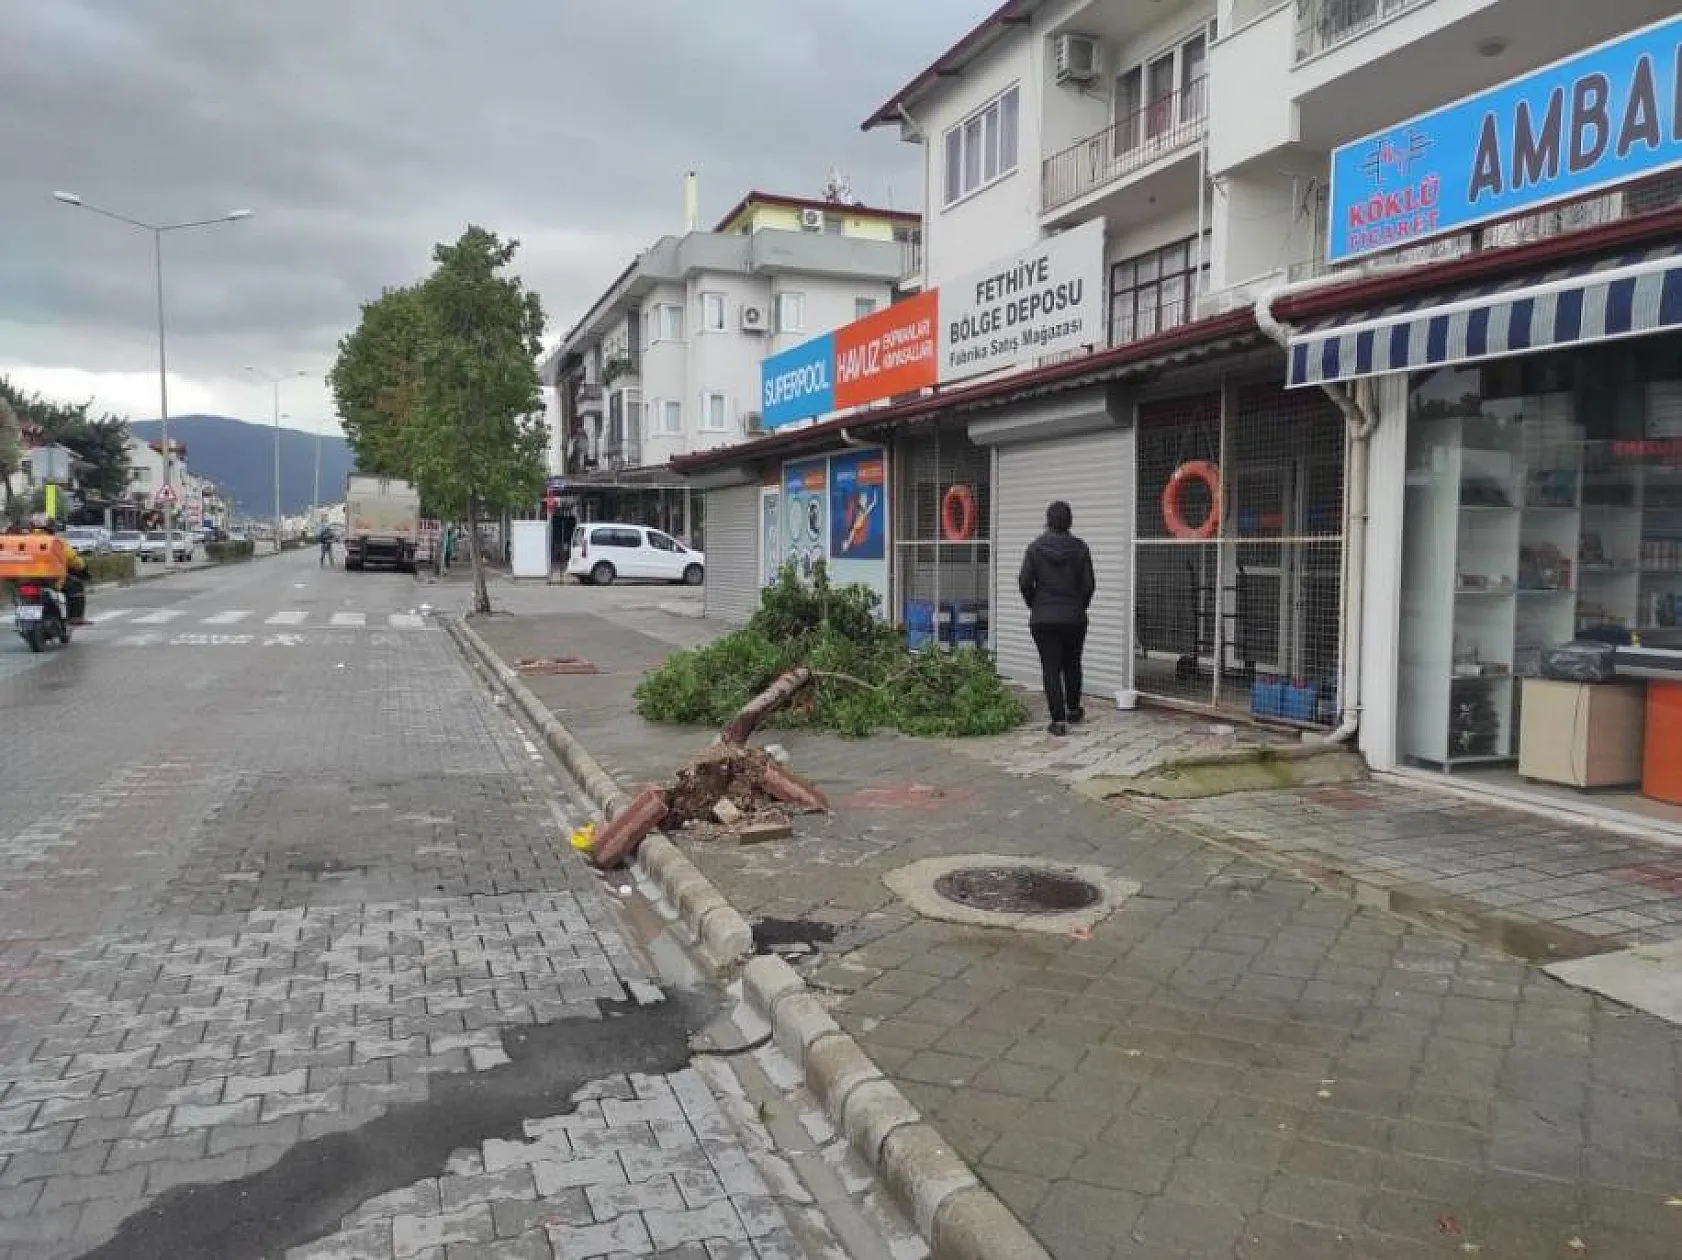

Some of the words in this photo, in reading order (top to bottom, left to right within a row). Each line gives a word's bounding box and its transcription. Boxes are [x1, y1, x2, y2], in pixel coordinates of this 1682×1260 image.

[1468, 43, 1682, 204] AMBA
[976, 255, 1049, 306] FETHİYE
[949, 307, 1001, 345] BÖLGE
[1006, 278, 1083, 326] DEPOSU
[765, 359, 831, 407] SUPERPOOL
[836, 338, 881, 384] HAVUZ
